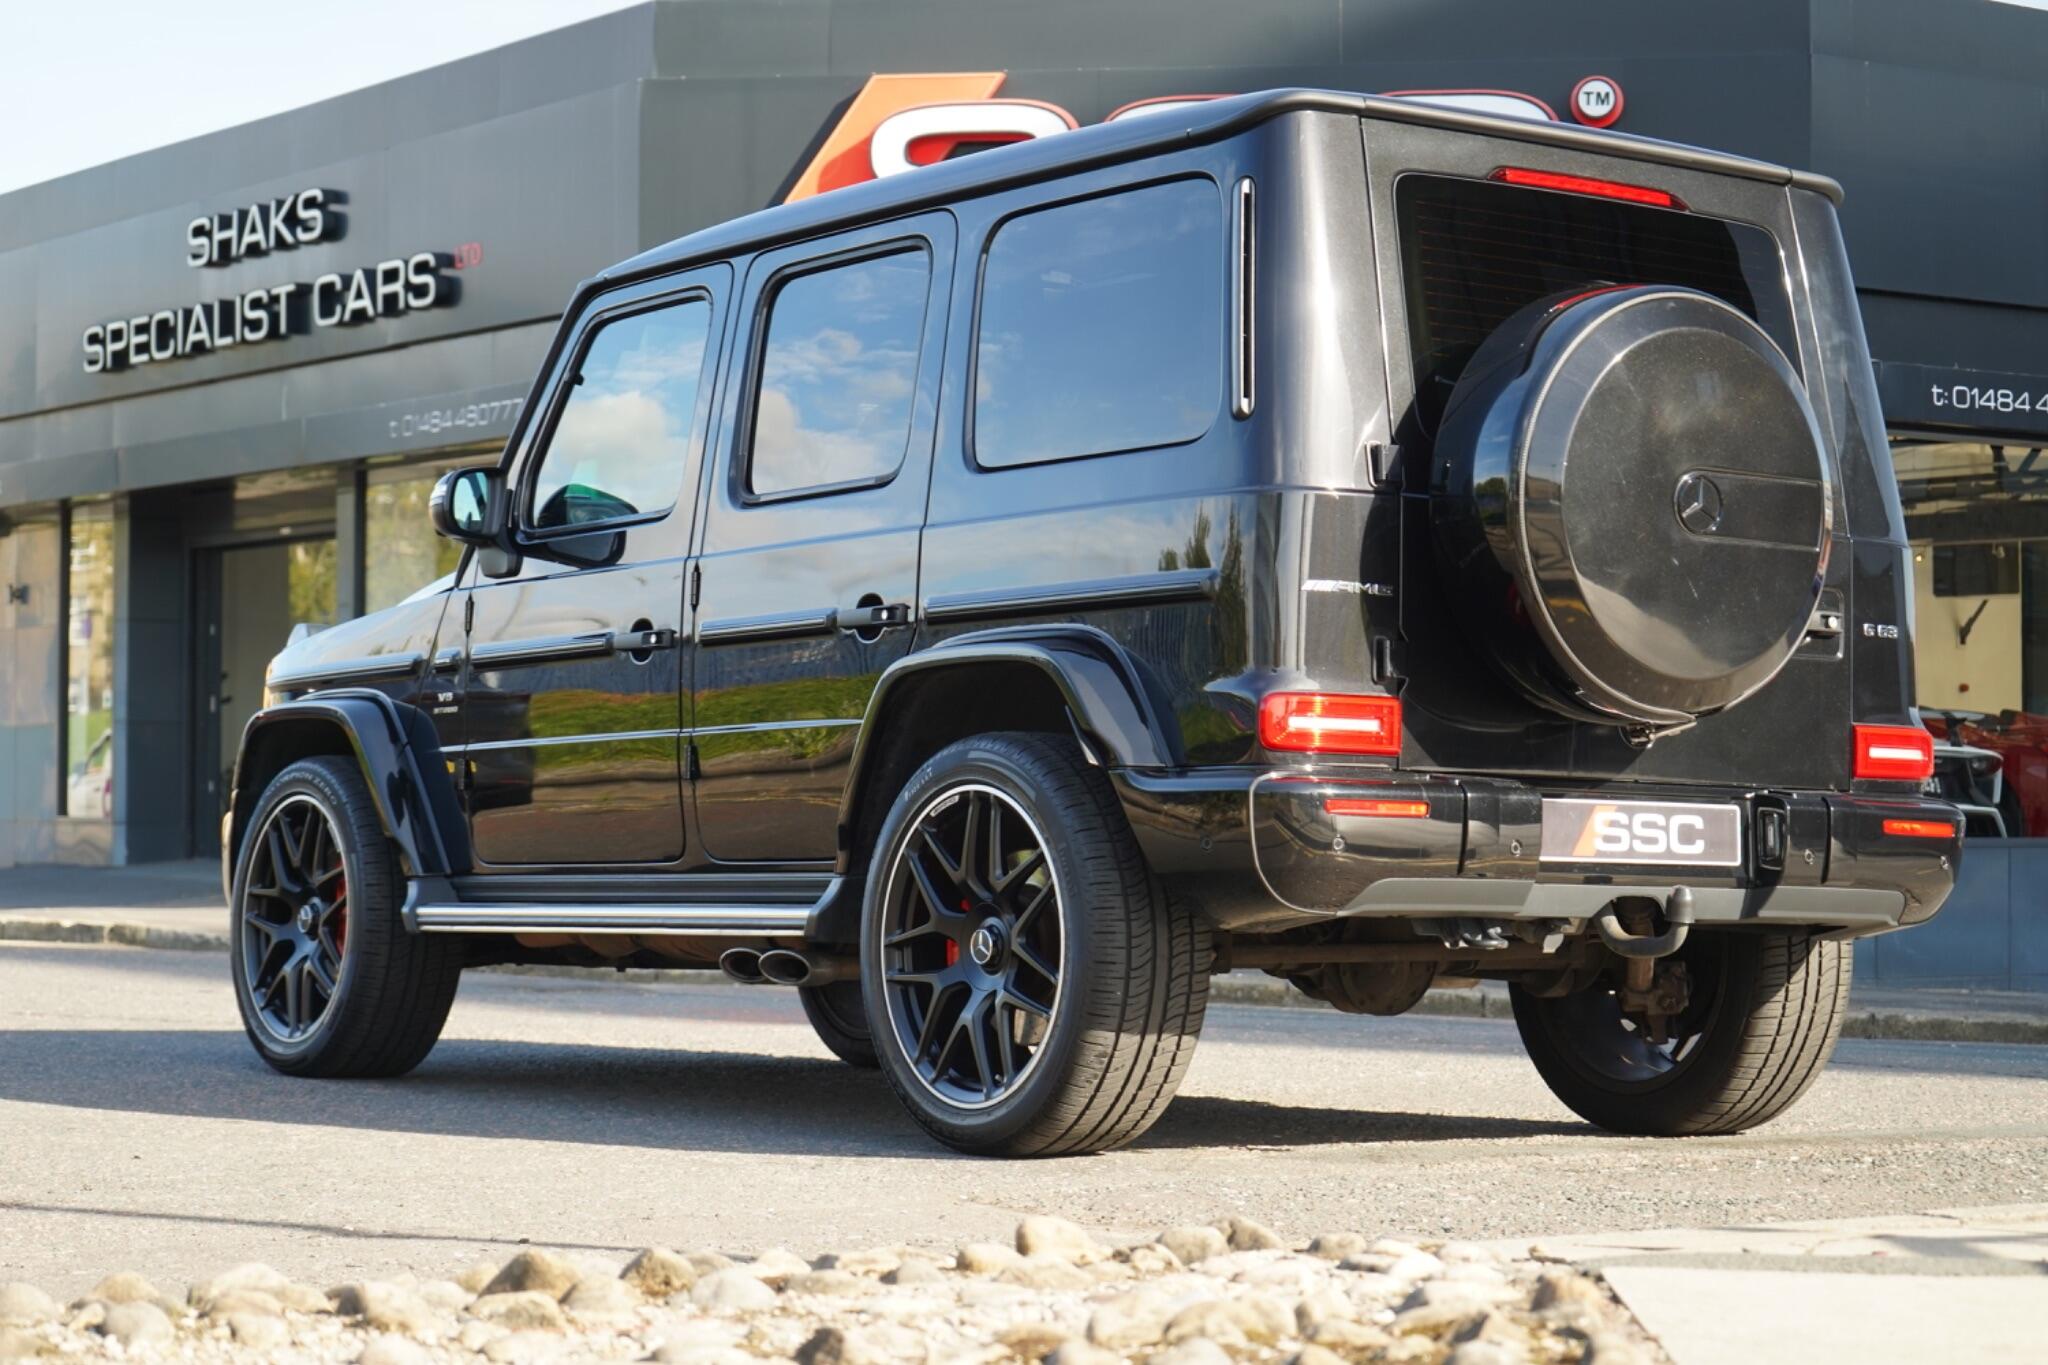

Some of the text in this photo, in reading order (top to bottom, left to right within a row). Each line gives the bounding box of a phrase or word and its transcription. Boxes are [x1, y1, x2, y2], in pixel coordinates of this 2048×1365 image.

[1583, 91, 1610, 106] TM
[187, 188, 324, 267] SHAKS
[83, 242, 483, 373] SPECIALIST CARS LTD
[1594, 811, 1705, 855] SSC
